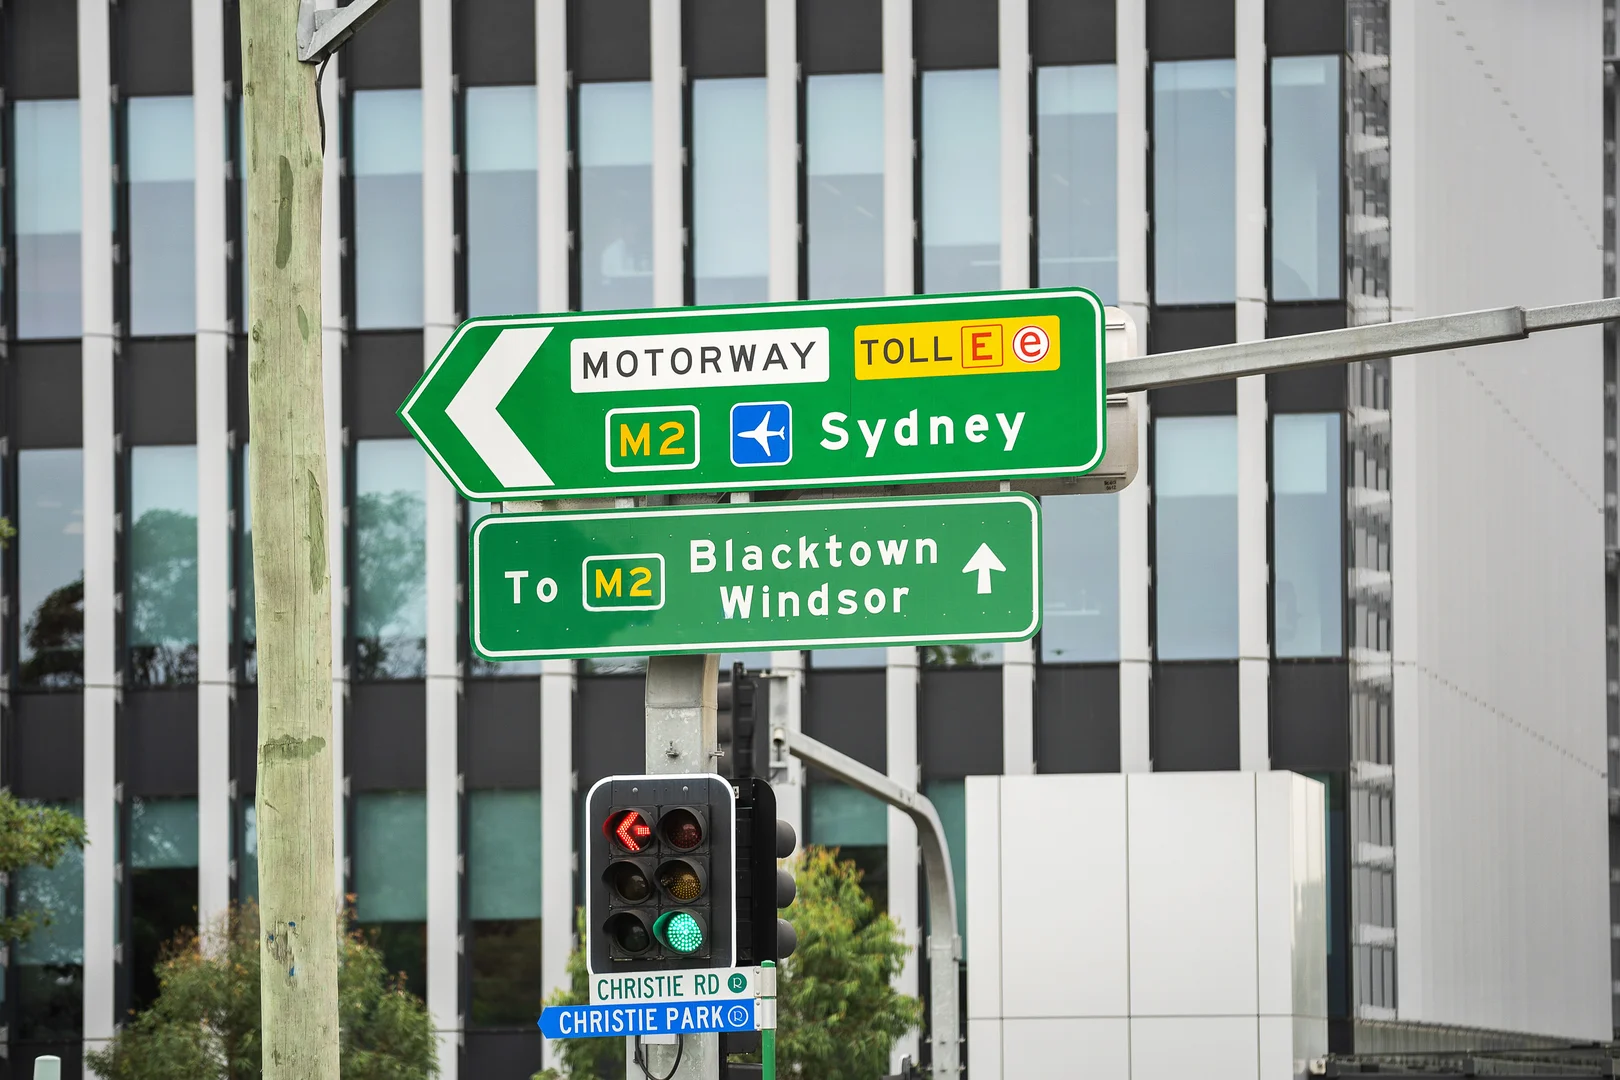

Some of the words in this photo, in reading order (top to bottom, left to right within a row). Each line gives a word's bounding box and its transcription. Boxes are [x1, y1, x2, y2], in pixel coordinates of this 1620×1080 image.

[583, 341, 818, 380] MOTORWAY
[860, 335, 953, 366] TOLL
[969, 331, 994, 362] E
[1018, 330, 1043, 359] e
[619, 421, 686, 458] M2
[819, 408, 1026, 458] Sydney
[690, 534, 938, 574] Blacktown
[504, 570, 558, 604] To
[594, 566, 653, 599] M2
[719, 582, 910, 620] Windsor
[597, 975, 684, 1001] CHRISTIE
[694, 973, 720, 996] RD
[559, 1008, 658, 1035] CHRISTIE
[666, 1005, 724, 1030] PARK
